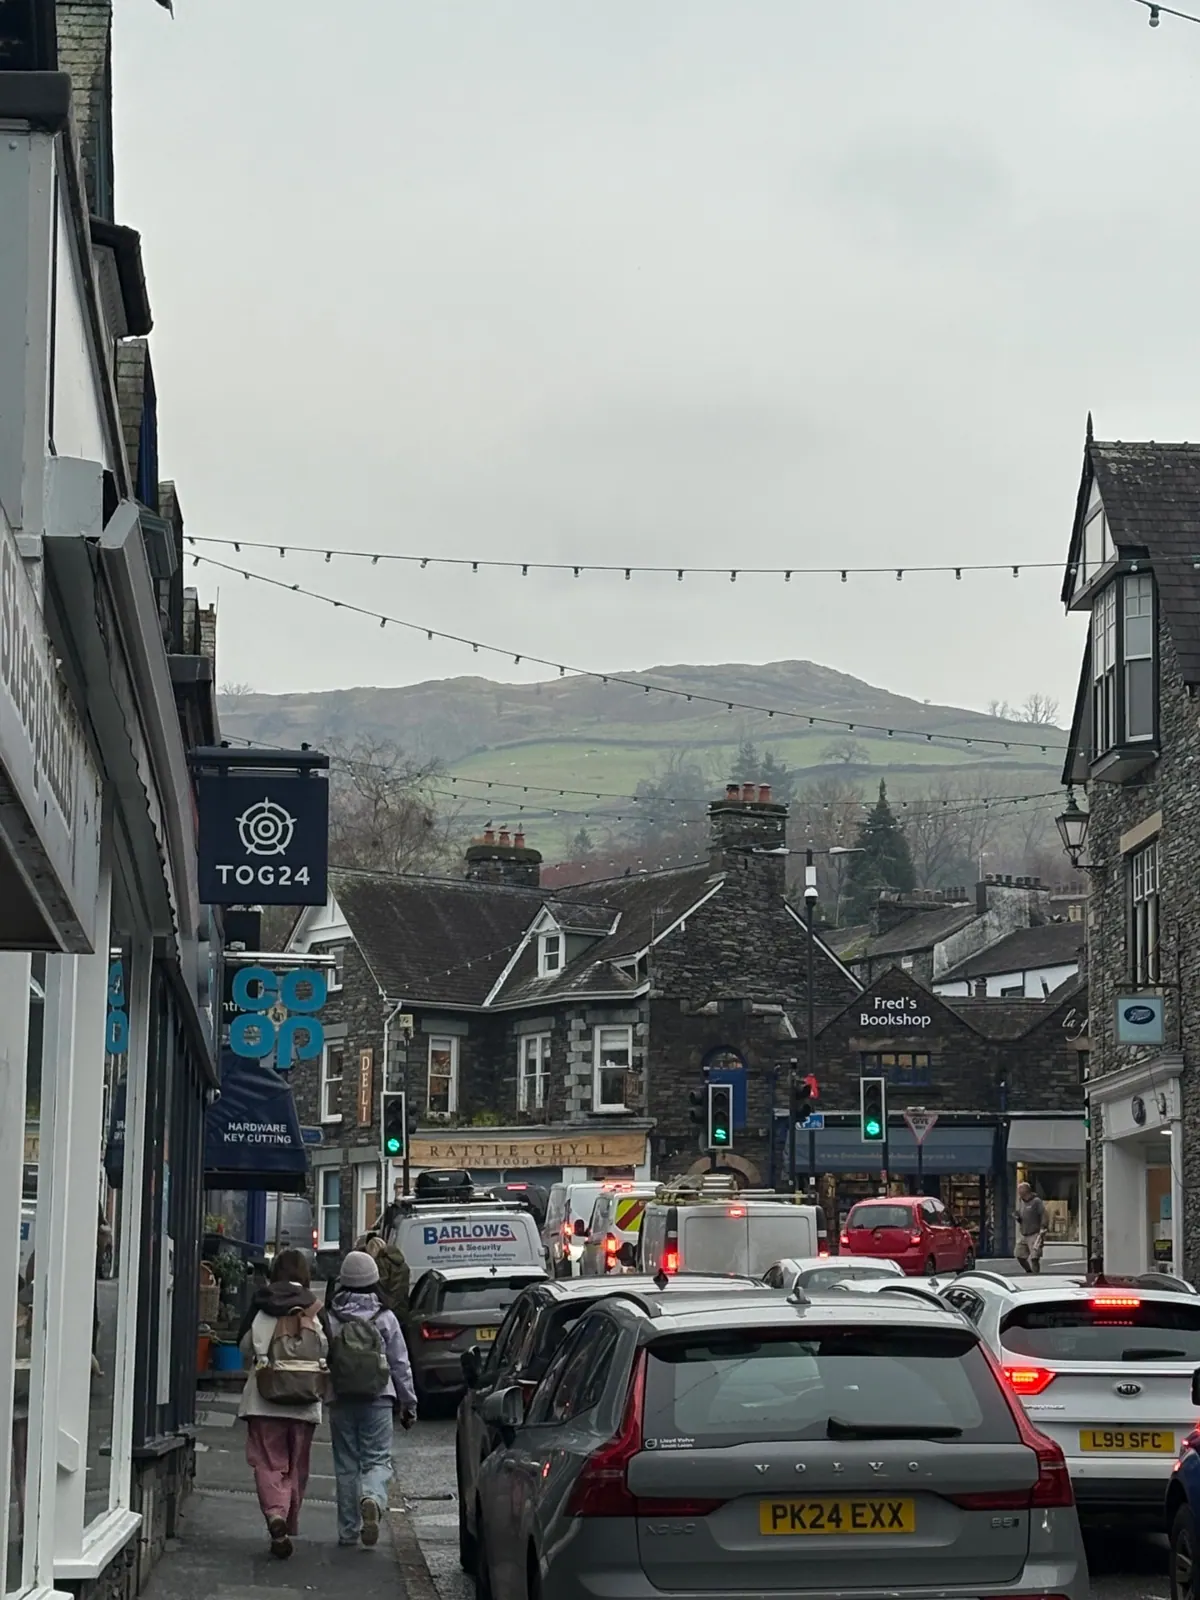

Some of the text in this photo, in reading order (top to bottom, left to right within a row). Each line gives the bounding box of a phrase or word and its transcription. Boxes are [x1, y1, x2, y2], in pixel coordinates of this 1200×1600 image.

[215, 864, 311, 886] TOG24
[874, 996, 917, 1010] Fred's
[860, 1012, 932, 1029] Bookshop
[361, 1055, 371, 1122] DELI
[228, 1121, 288, 1134] HARDWARE
[223, 1132, 292, 1145] KEY CUTTING
[430, 1143, 610, 1157] RATTLE GHYLL
[496, 1156, 529, 1166] FOOD
[423, 1224, 511, 1245] BARLOWS
[439, 1245, 456, 1253] Fire
[466, 1243, 502, 1252] Security
[1121, 1385, 1137, 1393] KIA
[1092, 1432, 1162, 1448] L99 SFC
[753, 1460, 919, 1474] VOLVO
[770, 1501, 904, 1530] PK24 EXX
